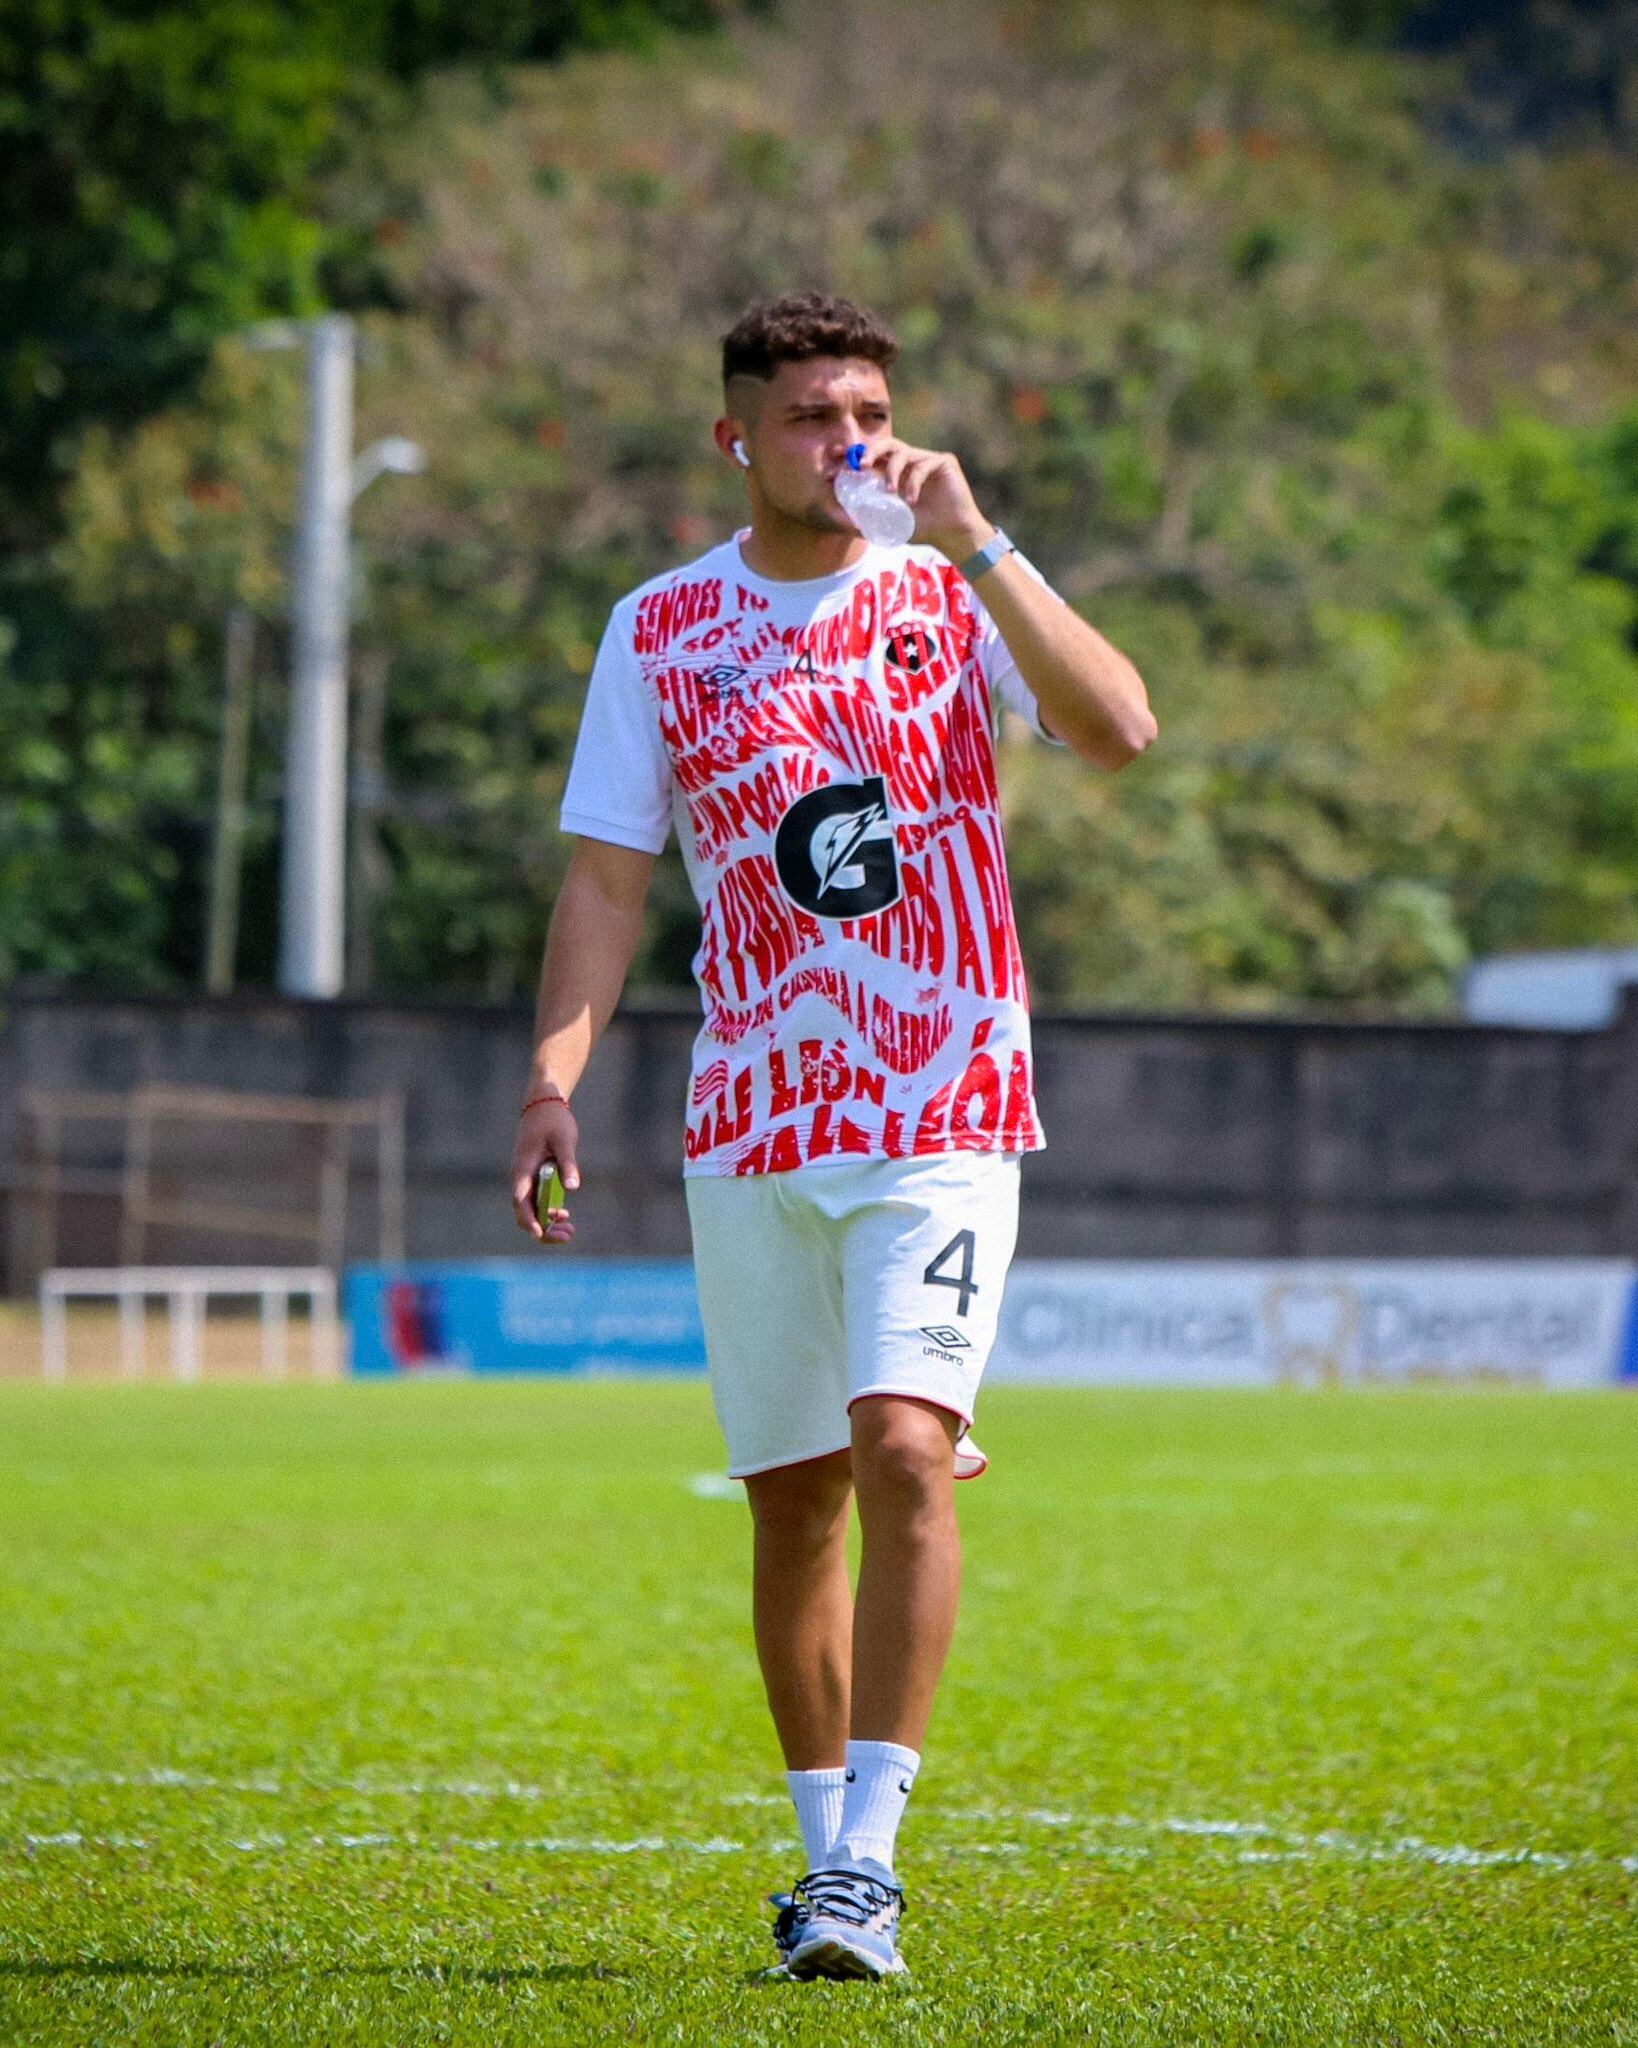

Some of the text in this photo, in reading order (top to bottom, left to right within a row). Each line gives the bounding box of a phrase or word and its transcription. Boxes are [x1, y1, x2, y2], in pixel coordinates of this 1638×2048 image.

[634, 576, 724, 654] SEÑORES
[794, 649, 819, 682] 4
[769, 1036, 887, 1119] LEÓN
[923, 1228, 979, 1317] 4
[922, 1346, 964, 1366] umbro
